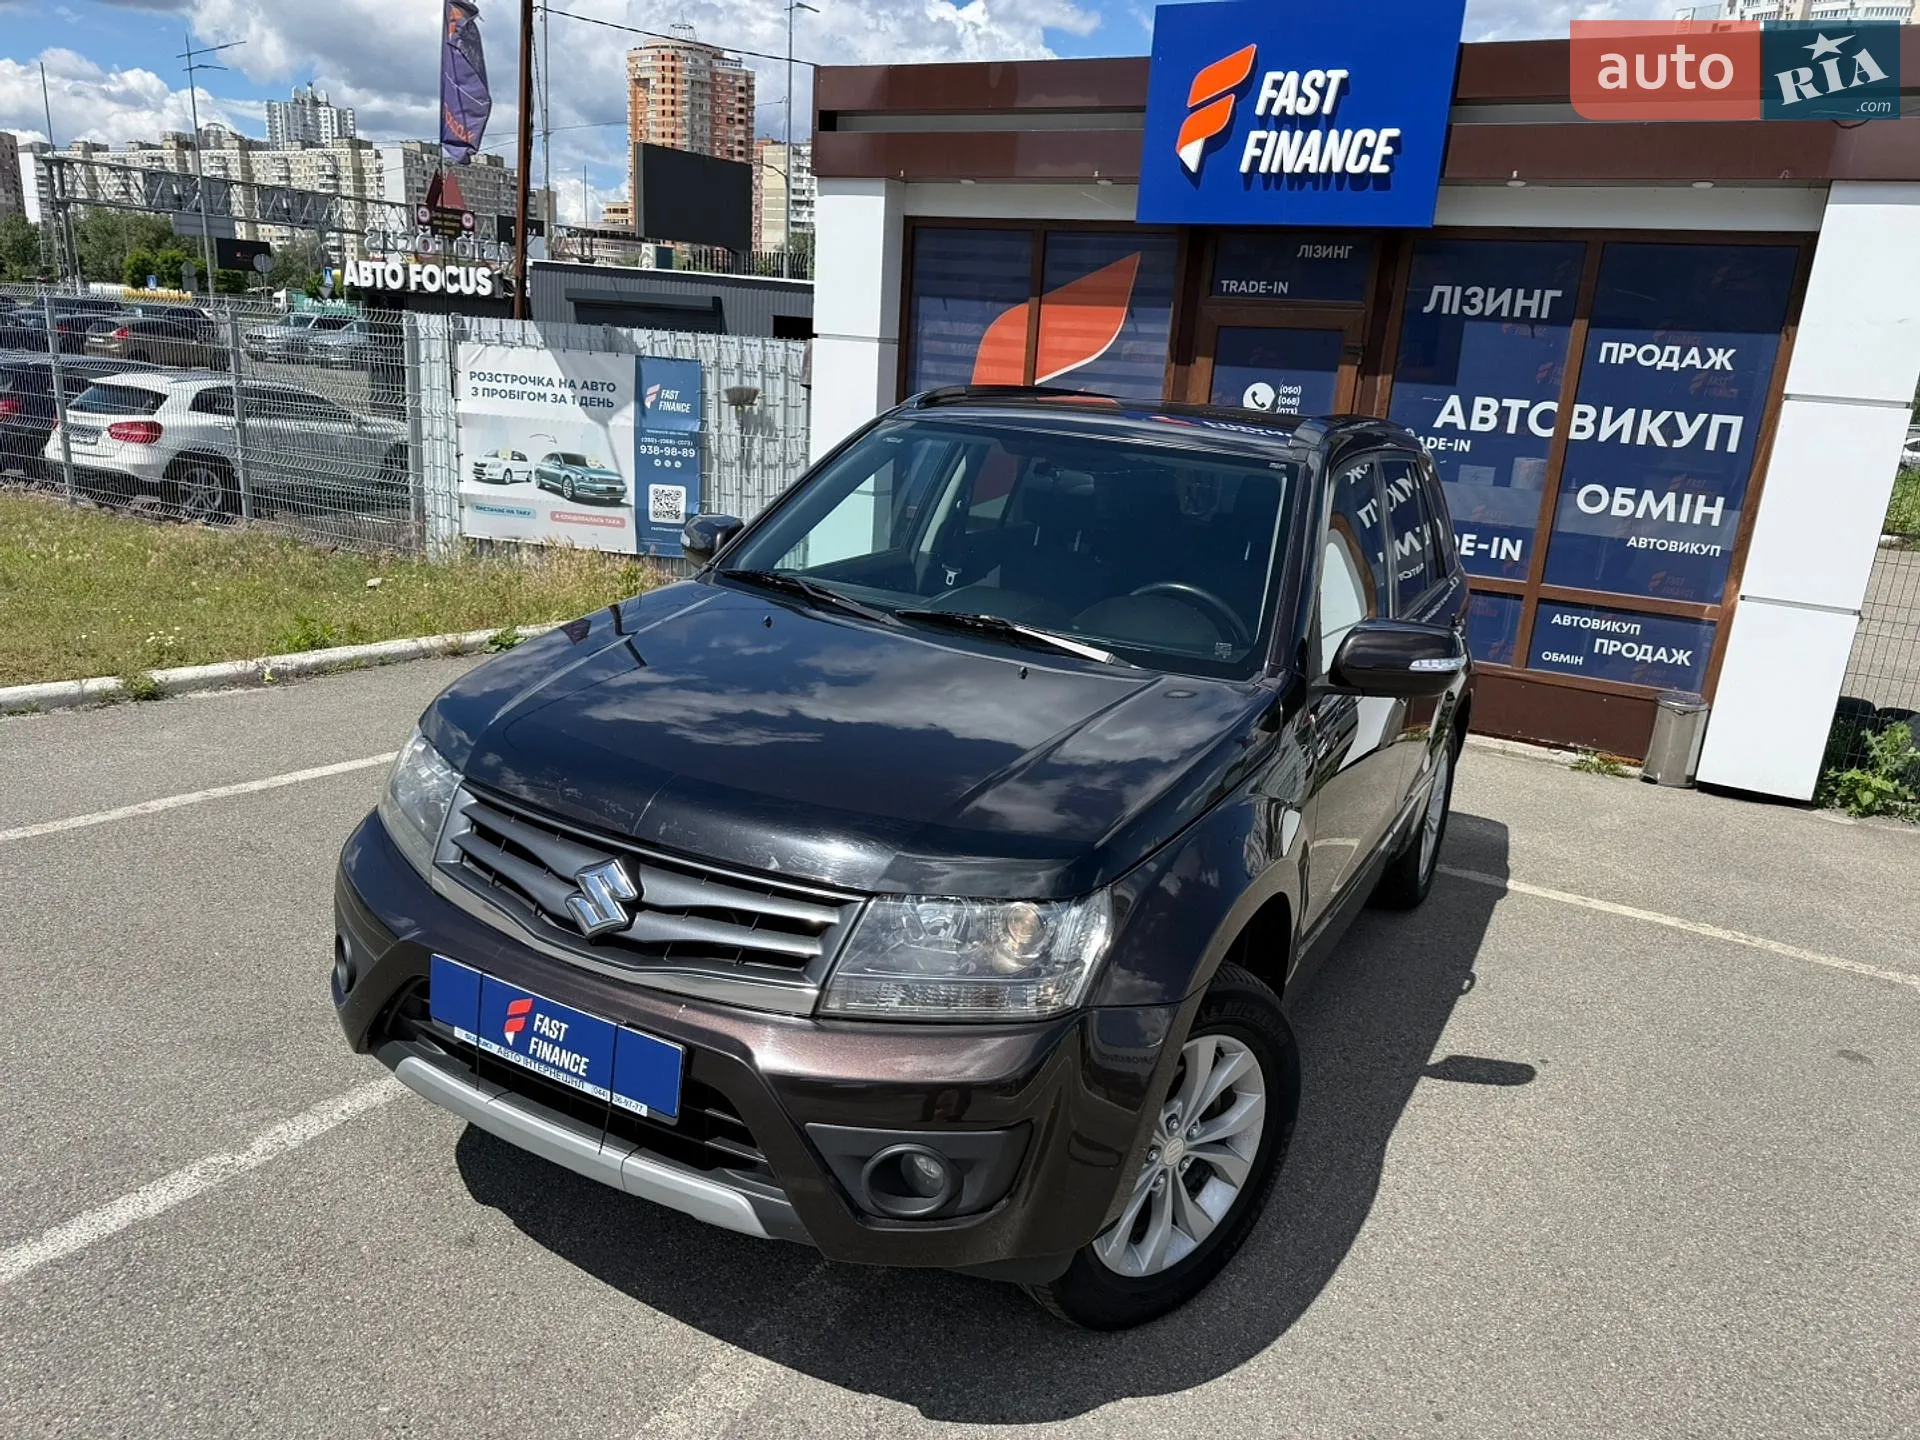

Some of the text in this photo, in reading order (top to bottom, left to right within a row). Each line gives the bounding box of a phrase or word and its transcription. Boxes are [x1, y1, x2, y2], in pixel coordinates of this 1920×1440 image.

[1255, 69, 1349, 116] FAST
[1239, 128, 1401, 174] FINANCE
[1297, 245, 1352, 259] ЛІЗИНГ
[343, 259, 493, 297] АВТО FOCUS
[1221, 280, 1289, 294] TRADE-IN
[1422, 285, 1562, 319] ЛІЗИНГ
[1599, 341, 1736, 371] ПРОДАЖ
[469, 371, 616, 393] РОЗСТРОЧКА НА АВТО
[660, 389, 680, 400] FAST
[482, 388, 547, 403] ПРОБІГОМ
[550, 393, 567, 404] ЗА
[571, 395, 576, 405] 1
[579, 396, 614, 408] ДЕНЬ
[658, 401, 692, 413] FINANCE
[1433, 394, 1744, 453] АВТОВИКУП
[640, 445, 695, 458] 938-98-89
[1576, 484, 1725, 527] ОБМІН
[1626, 536, 1721, 557] АВТОВИКУП
[1551, 613, 1641, 635] АВТОВИКУП
[1541, 651, 1584, 665] ОБМІН
[1593, 638, 1692, 666] ПРОДАЖ
[533, 1013, 569, 1042] FAST
[528, 1036, 589, 1077] FINANCE
